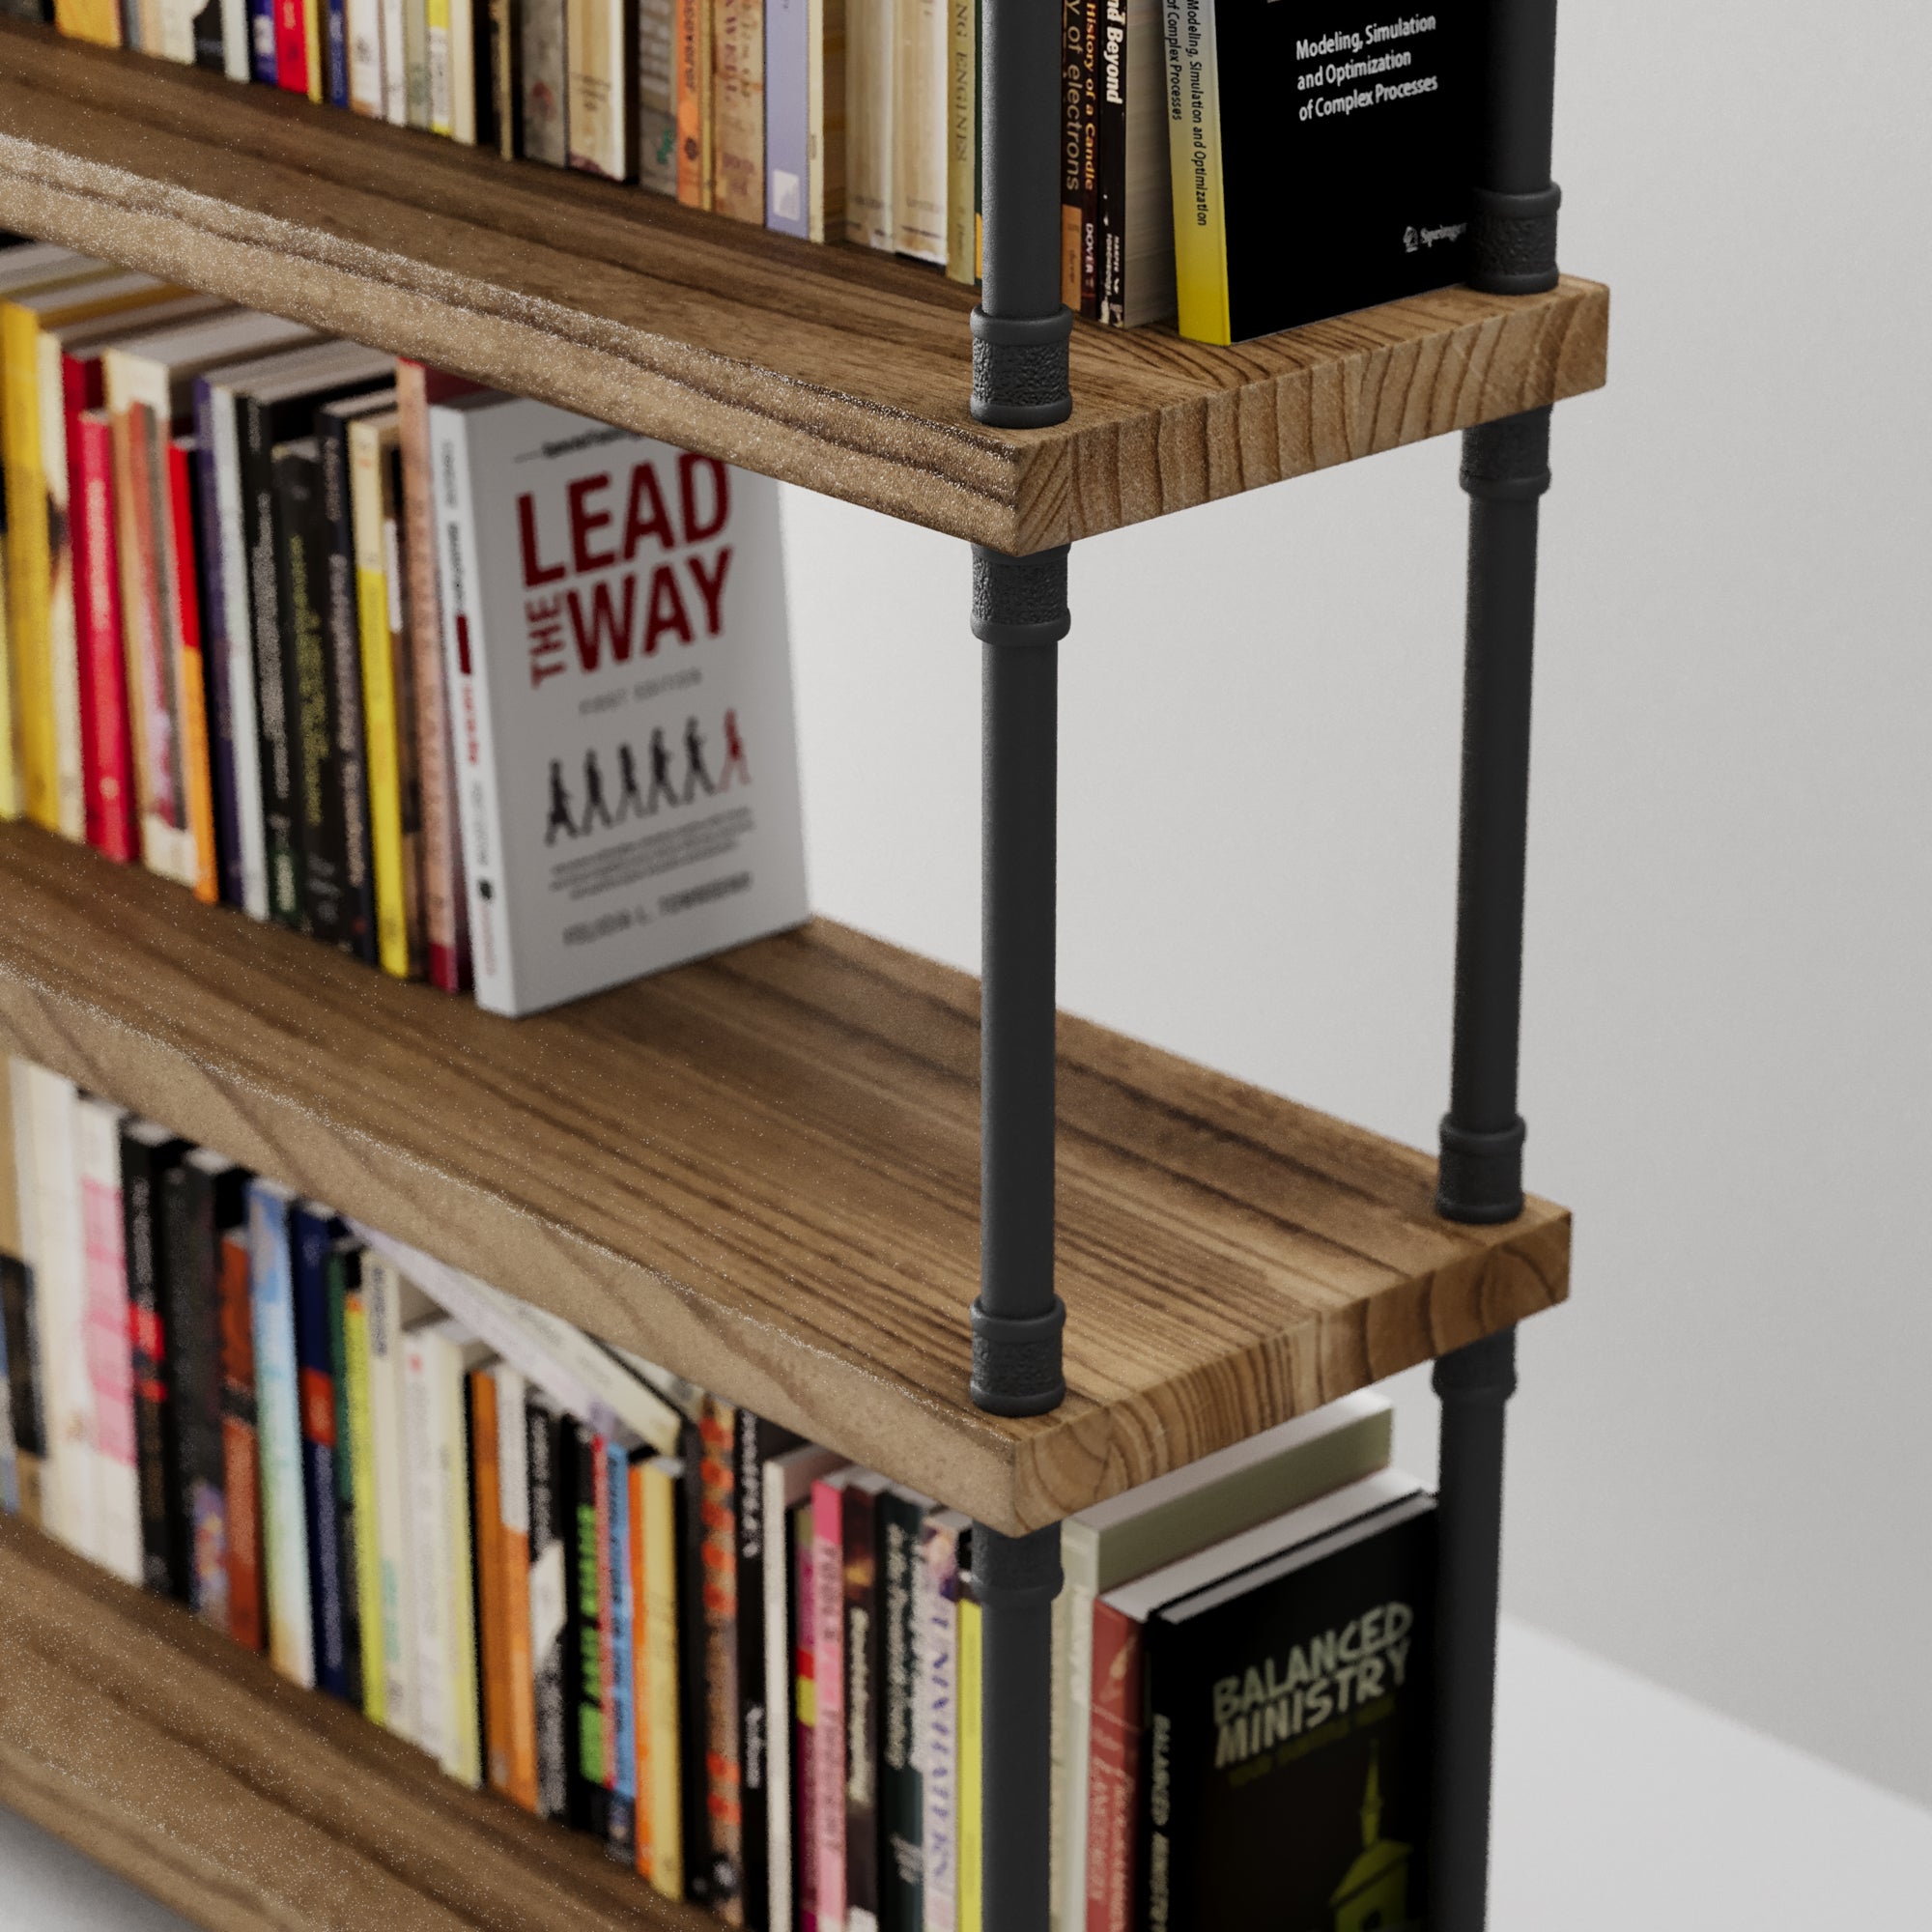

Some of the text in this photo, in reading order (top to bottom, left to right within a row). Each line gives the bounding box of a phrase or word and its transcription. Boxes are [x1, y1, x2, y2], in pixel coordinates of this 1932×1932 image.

[1066, 26, 1083, 54] of
[1103, 26, 1123, 104] Beyond
[1164, 12, 1181, 62] Complex
[1295, 14, 1436, 60] Modeling, Simulation
[1297, 49, 1411, 91] and Optimization
[954, 51, 968, 162] ENGINES
[1065, 64, 1083, 190] electrons
[1084, 2, 1096, 190] History of a Candle
[1169, 64, 1183, 121] Processes
[1185, 0, 1209, 226] Modeling, Simulation and Optimization
[1298, 75, 1438, 121] of Complex Processes
[1085, 222, 1094, 273] DOVER
[516, 450, 731, 587] LEAD
[525, 591, 566, 690] THE
[566, 544, 733, 673] WAY
[1212, 1602, 1414, 1727] BALANCED
[1214, 1636, 1410, 1769] MINISTRY
